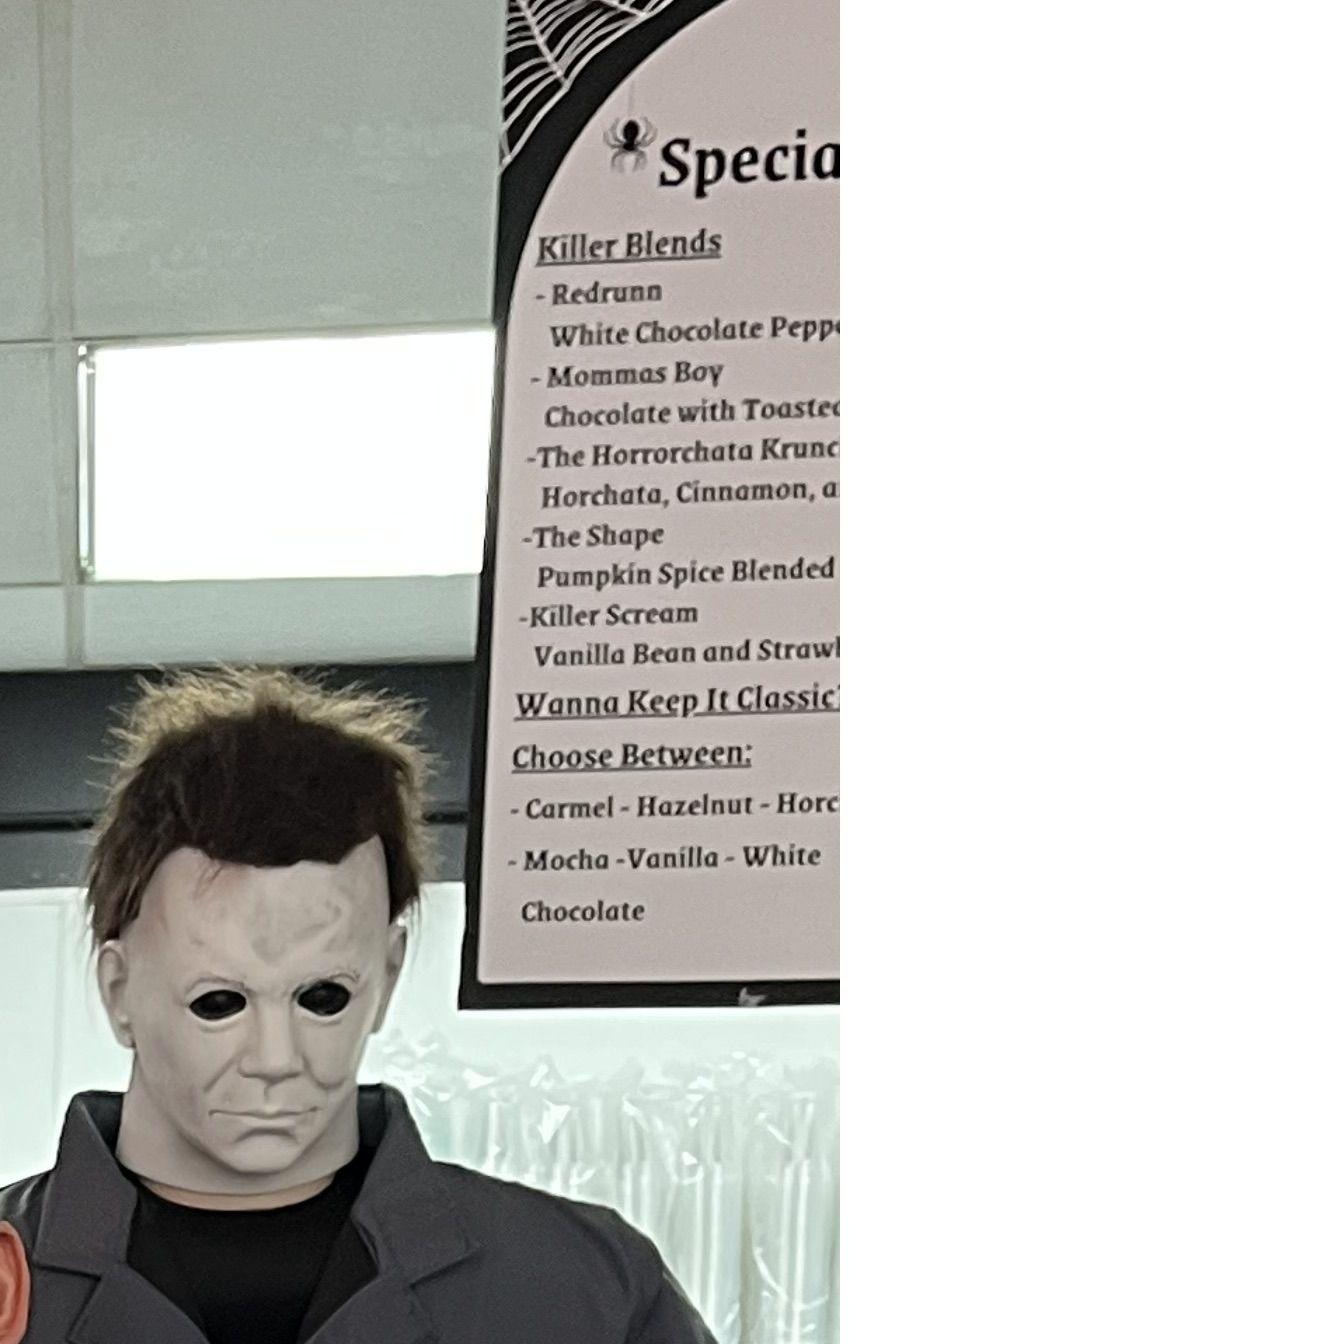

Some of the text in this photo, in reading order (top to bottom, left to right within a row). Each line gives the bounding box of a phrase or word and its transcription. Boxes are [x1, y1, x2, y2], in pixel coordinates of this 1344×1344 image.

[538, 228, 721, 262] Killer Blends
[553, 281, 662, 305] Redrunn
[550, 323, 629, 347] White
[636, 317, 763, 343] Chocolate
[547, 366, 666, 387] Mommas
[675, 361, 723, 387] Boy
[545, 404, 670, 427] Chocolate
[678, 400, 735, 422] with
[592, 440, 752, 466] Horrorchata
[543, 484, 669, 508] Horchata,
[677, 480, 814, 503] Cinnamon,
[587, 524, 664, 550] Shape
[538, 556, 834, 590] Pumpkin Spice Blended
[606, 604, 697, 625] Scream
[535, 636, 840, 666] Vanilla Bean and Straw
[514, 693, 622, 719] Wanna
[626, 690, 700, 718] Keep
[704, 688, 732, 713] It
[513, 744, 752, 771] Choose Between:
[526, 796, 613, 819] Carmel
[637, 794, 752, 817] Hazelnut
[524, 849, 608, 871] Mocha
[743, 844, 821, 867] White
[522, 900, 644, 922] Chocolate
